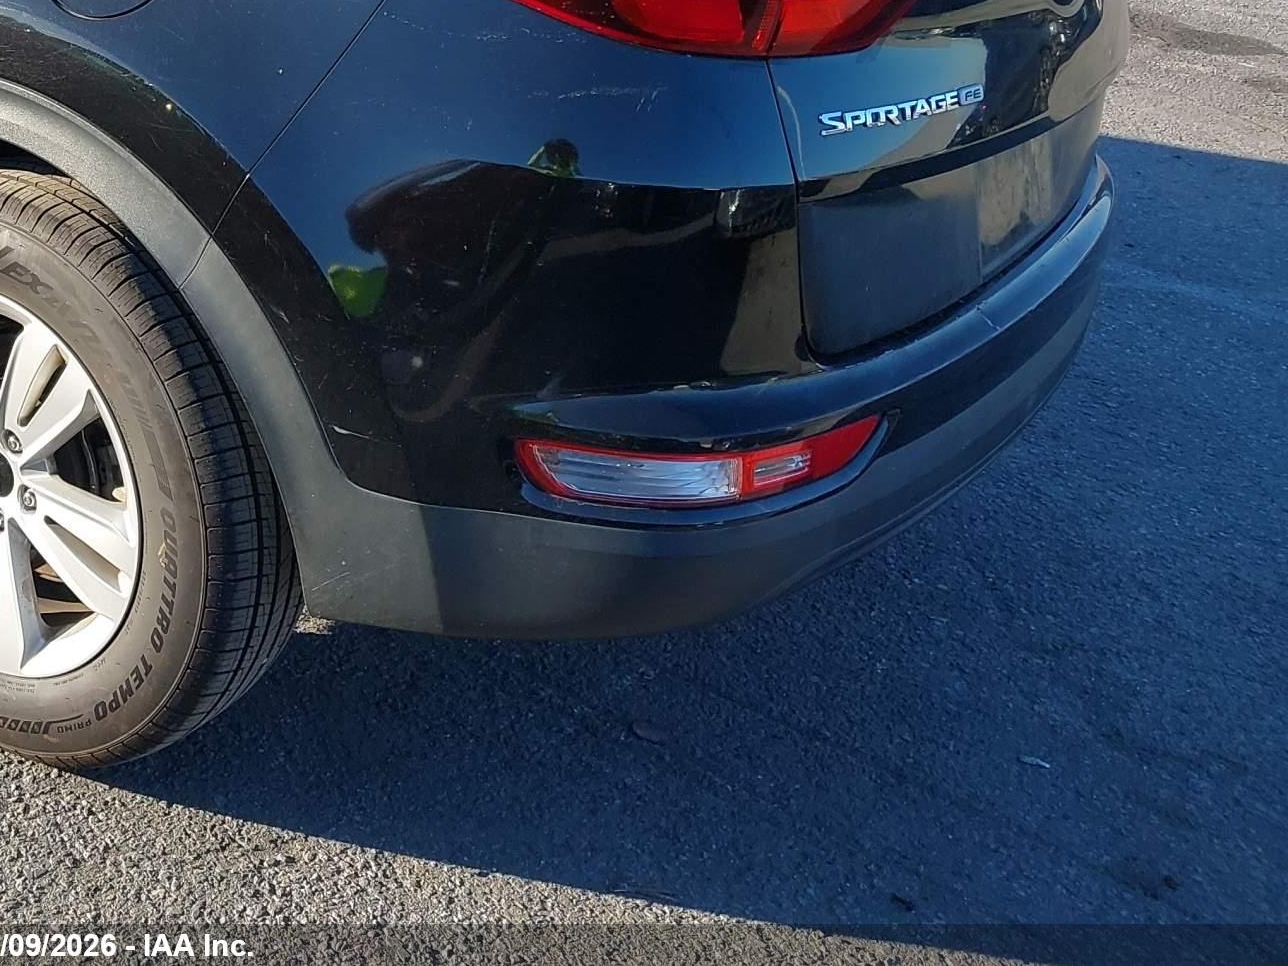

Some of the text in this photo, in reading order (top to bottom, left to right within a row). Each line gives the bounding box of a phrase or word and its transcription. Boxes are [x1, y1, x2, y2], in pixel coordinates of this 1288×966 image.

[818, 90, 960, 136] SPORTAGE
[150, 506, 179, 654] QUATTRO
[93, 653, 153, 721] TEMPO
[56, 718, 92, 734] PRIMO
